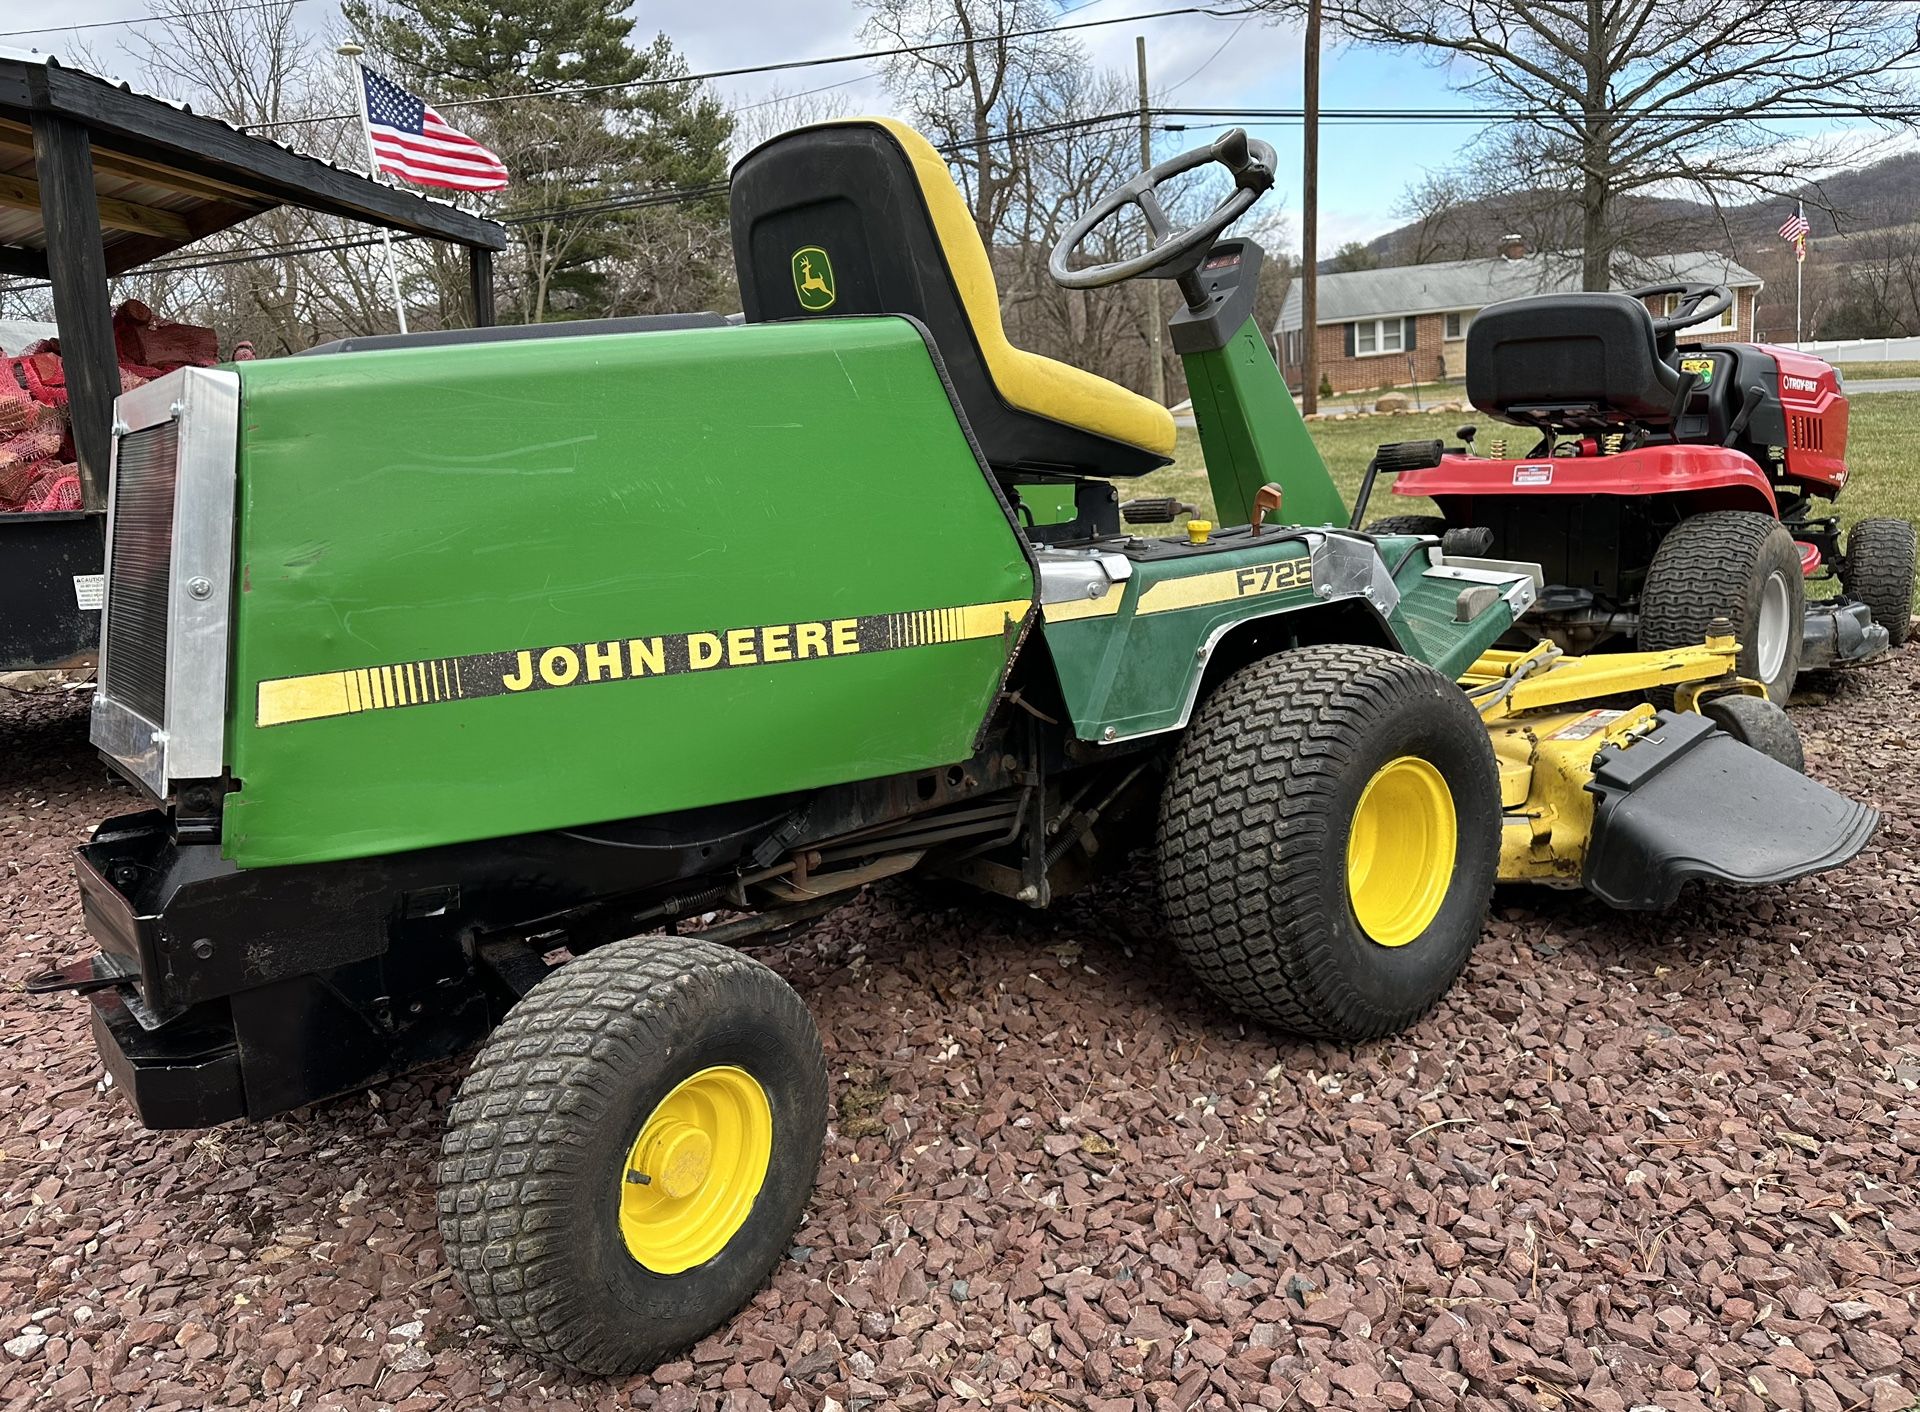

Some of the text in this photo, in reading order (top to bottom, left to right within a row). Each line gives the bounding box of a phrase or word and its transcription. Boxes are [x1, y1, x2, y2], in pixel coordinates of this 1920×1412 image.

[1236, 558, 1312, 596] F725
[502, 618, 860, 692] JOHN DEERE
